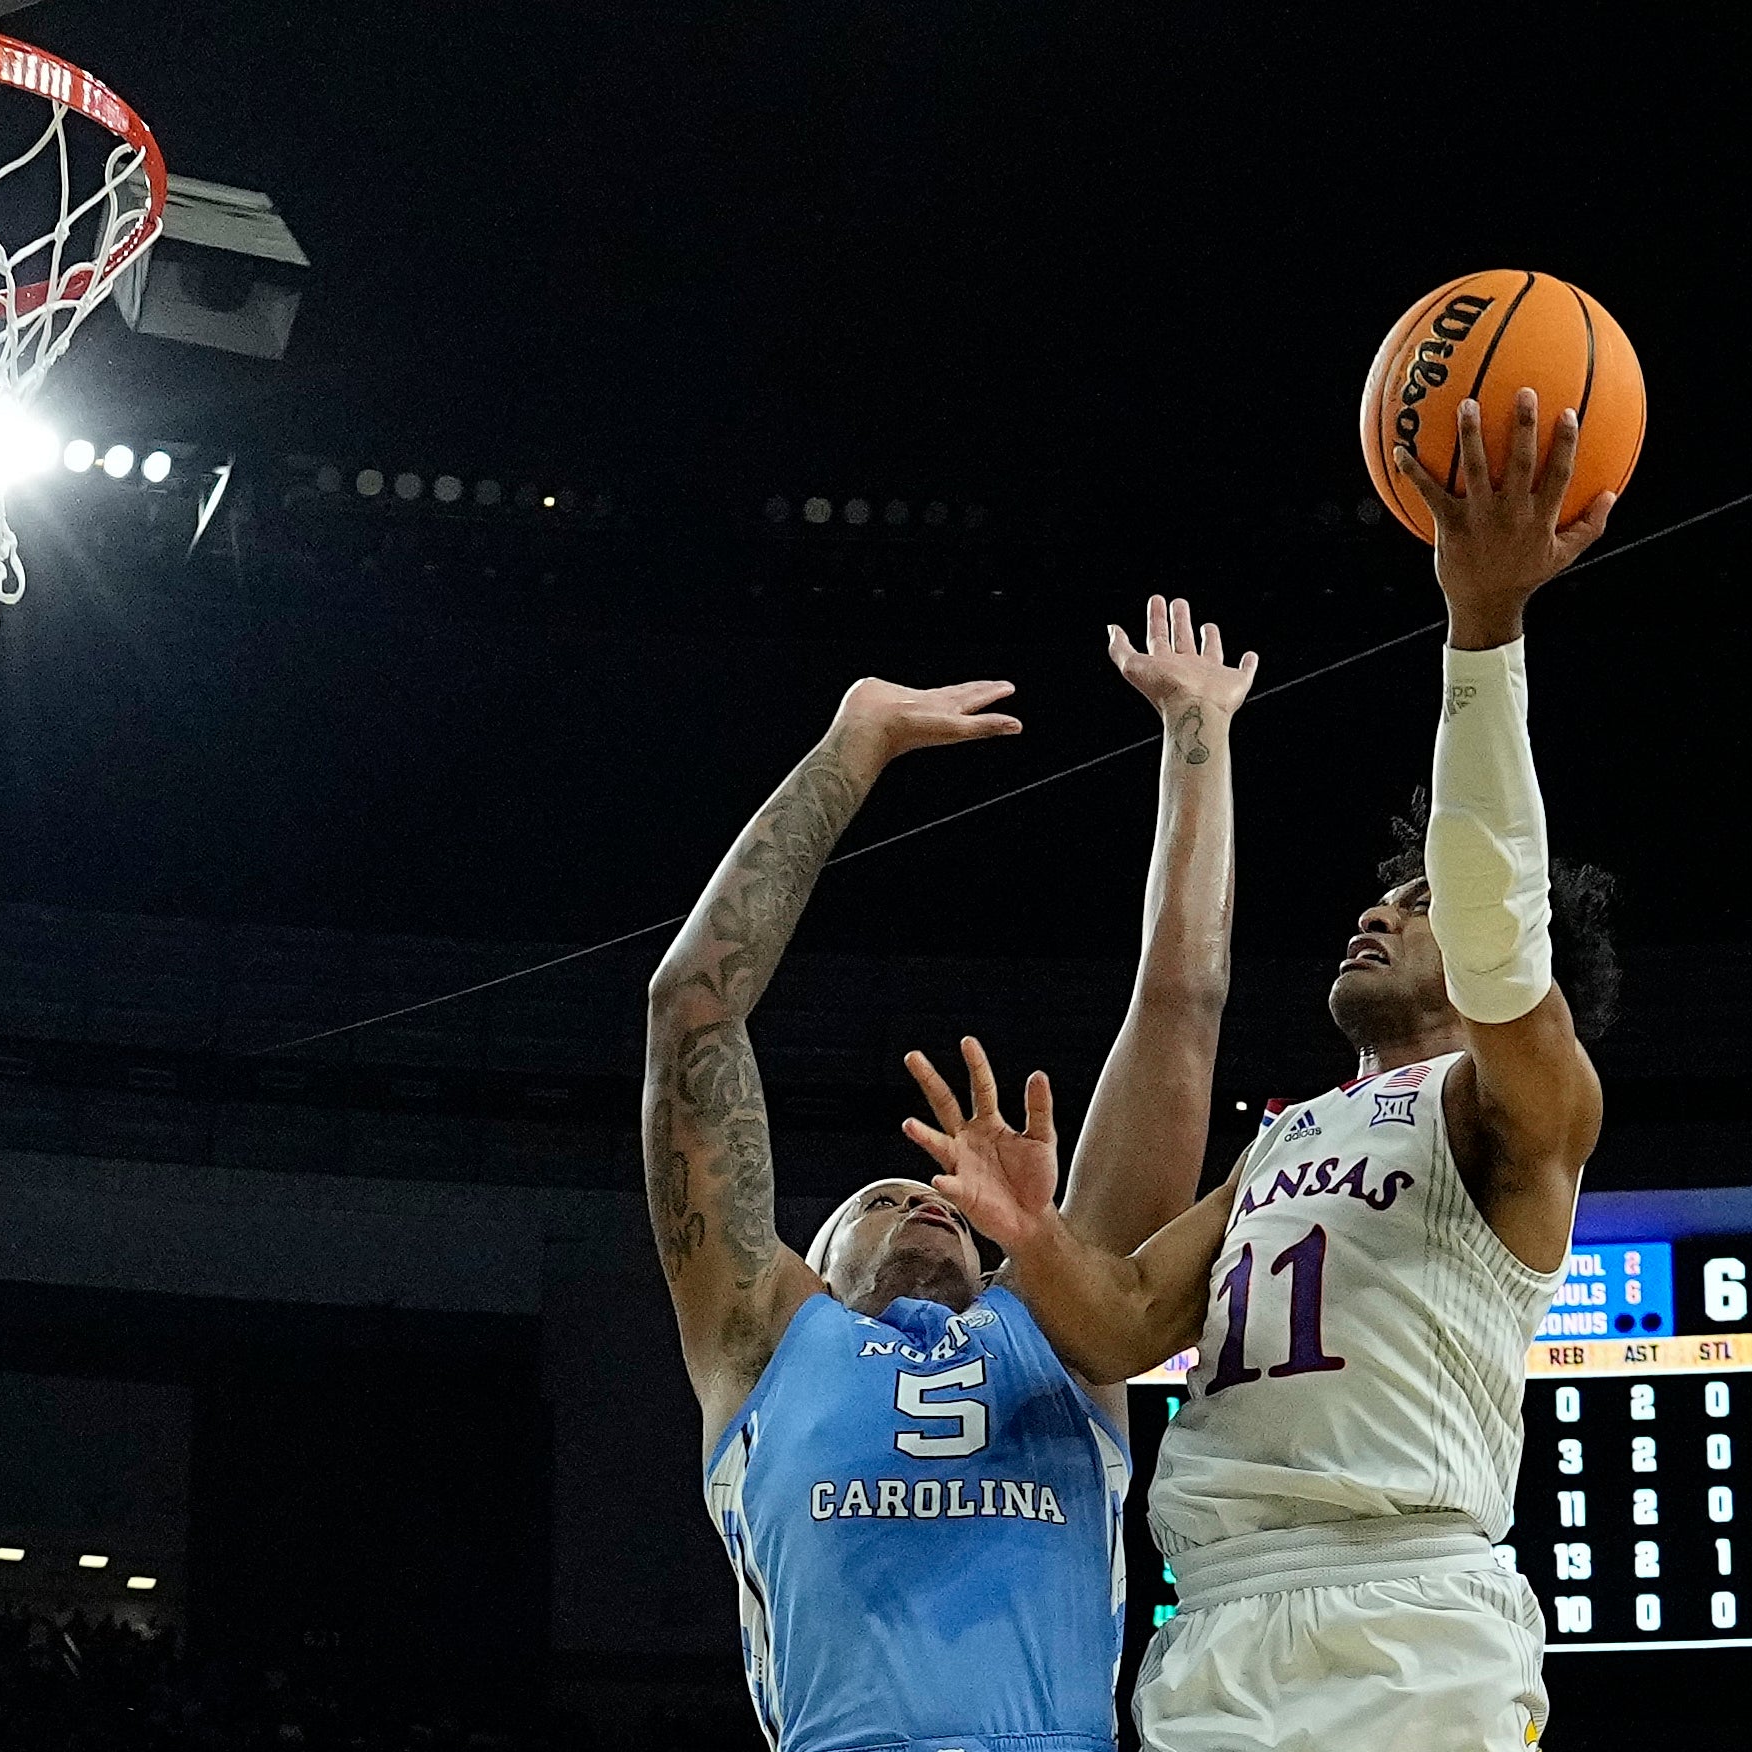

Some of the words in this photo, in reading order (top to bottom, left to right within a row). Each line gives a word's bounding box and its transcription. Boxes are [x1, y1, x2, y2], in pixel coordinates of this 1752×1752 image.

[1237, 1156, 1415, 1218] ANSAS
[1570, 1254, 1606, 1276] TOL
[1204, 1223, 1346, 1397] 11
[1553, 1282, 1606, 1306] OULS
[1550, 1346, 1584, 1366] REB
[1625, 1343, 1659, 1363] AST
[1699, 1341, 1733, 1361] STL
[894, 1356, 990, 1459] 5
[1556, 1387, 1580, 1422] 0
[1631, 1384, 1655, 1420] 2
[1705, 1382, 1729, 1417] 0
[1558, 1439, 1583, 1474] 3
[1632, 1437, 1657, 1472] 2
[1707, 1434, 1731, 1469] 0
[810, 1479, 1066, 1525] CAROLINA
[1558, 1491, 1585, 1527] 11
[1633, 1489, 1658, 1525] 2
[1708, 1486, 1733, 1522] 0
[1554, 1543, 1591, 1580] 13
[1635, 1541, 1659, 1578] 2
[1715, 1538, 1731, 1575] 1
[1555, 1596, 1592, 1633] 10
[1636, 1594, 1661, 1631] 0
[1711, 1591, 1736, 1628] 0
